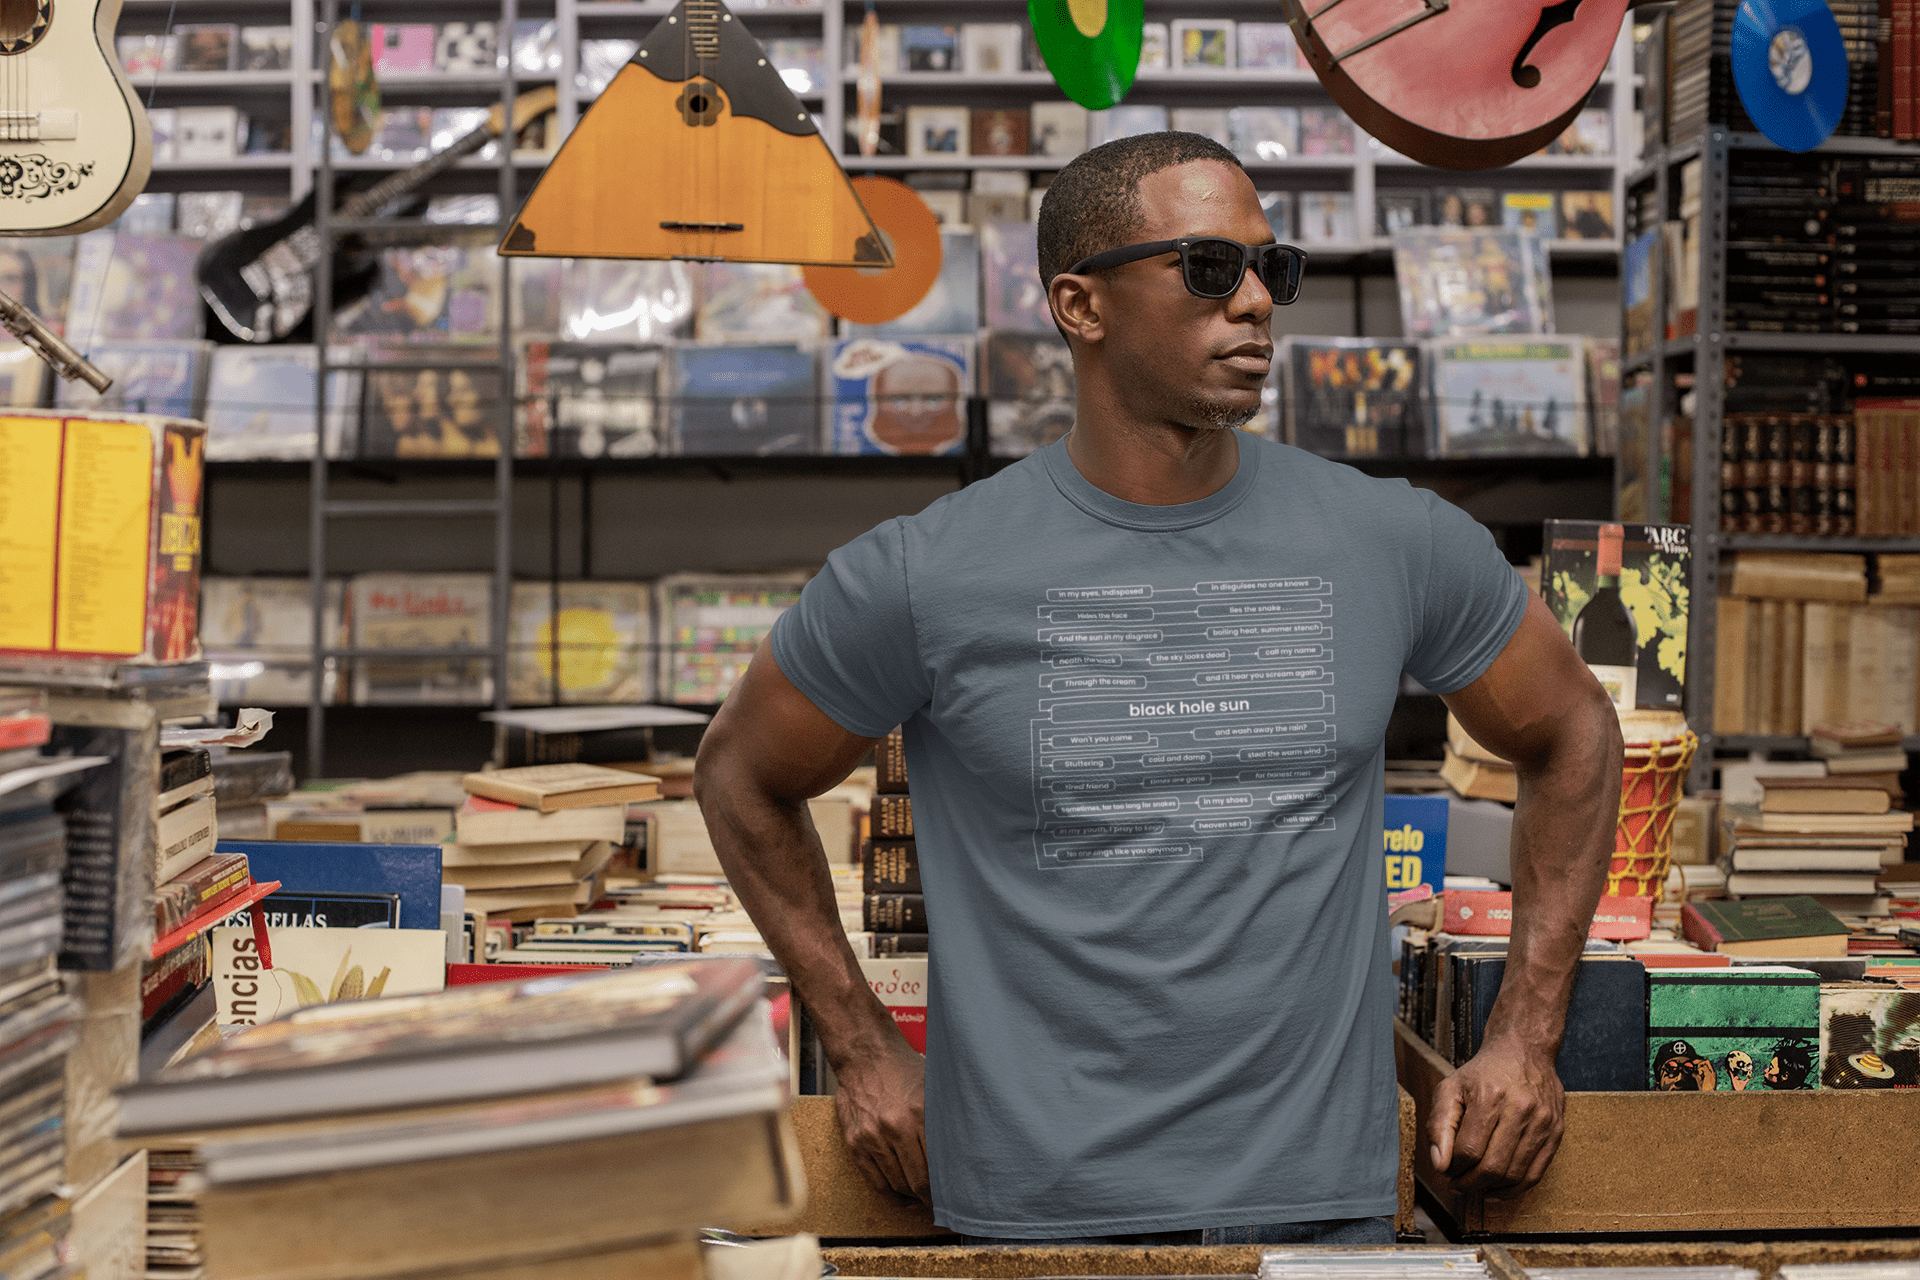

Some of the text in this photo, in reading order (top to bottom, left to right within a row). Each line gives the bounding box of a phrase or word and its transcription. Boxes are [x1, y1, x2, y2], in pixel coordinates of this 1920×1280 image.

[1648, 526, 1686, 544] ABC
[1220, 582, 1256, 592] disguises
[1067, 590, 1079, 598] my
[1230, 606, 1242, 614] lies
[1258, 604, 1280, 612] snake
[1294, 624, 1319, 632] stench
[1112, 634, 1124, 642] my
[1126, 632, 1158, 642] disgrace
[1265, 648, 1280, 656] call
[1156, 654, 1169, 662] the
[1170, 654, 1182, 662] sky
[1206, 674, 1220, 682] and
[1231, 672, 1248, 680] hear
[1250, 672, 1264, 681] you
[1266, 670, 1294, 678] scream
[1295, 668, 1317, 678] again
[1065, 678, 1098, 688] Through
[1129, 700, 1250, 716] black hole sun
[1215, 728, 1230, 736] and
[1232, 727, 1252, 735] wash
[1070, 734, 1132, 744] Won't you come
[1182, 754, 1206, 762] damp
[1064, 760, 1104, 768] Stuttering
[1186, 776, 1206, 784] gone
[1212, 798, 1224, 806] my
[1226, 796, 1248, 804] shoes
[1276, 792, 1304, 801] walking
[1126, 802, 1142, 810] long
[880, 797, 888, 834] AMADO
[1198, 820, 1247, 830] heaven send
[1131, 848, 1146, 856] you
[873, 846, 881, 883] AMADO
[225, 911, 327, 928] ESRELLAS
